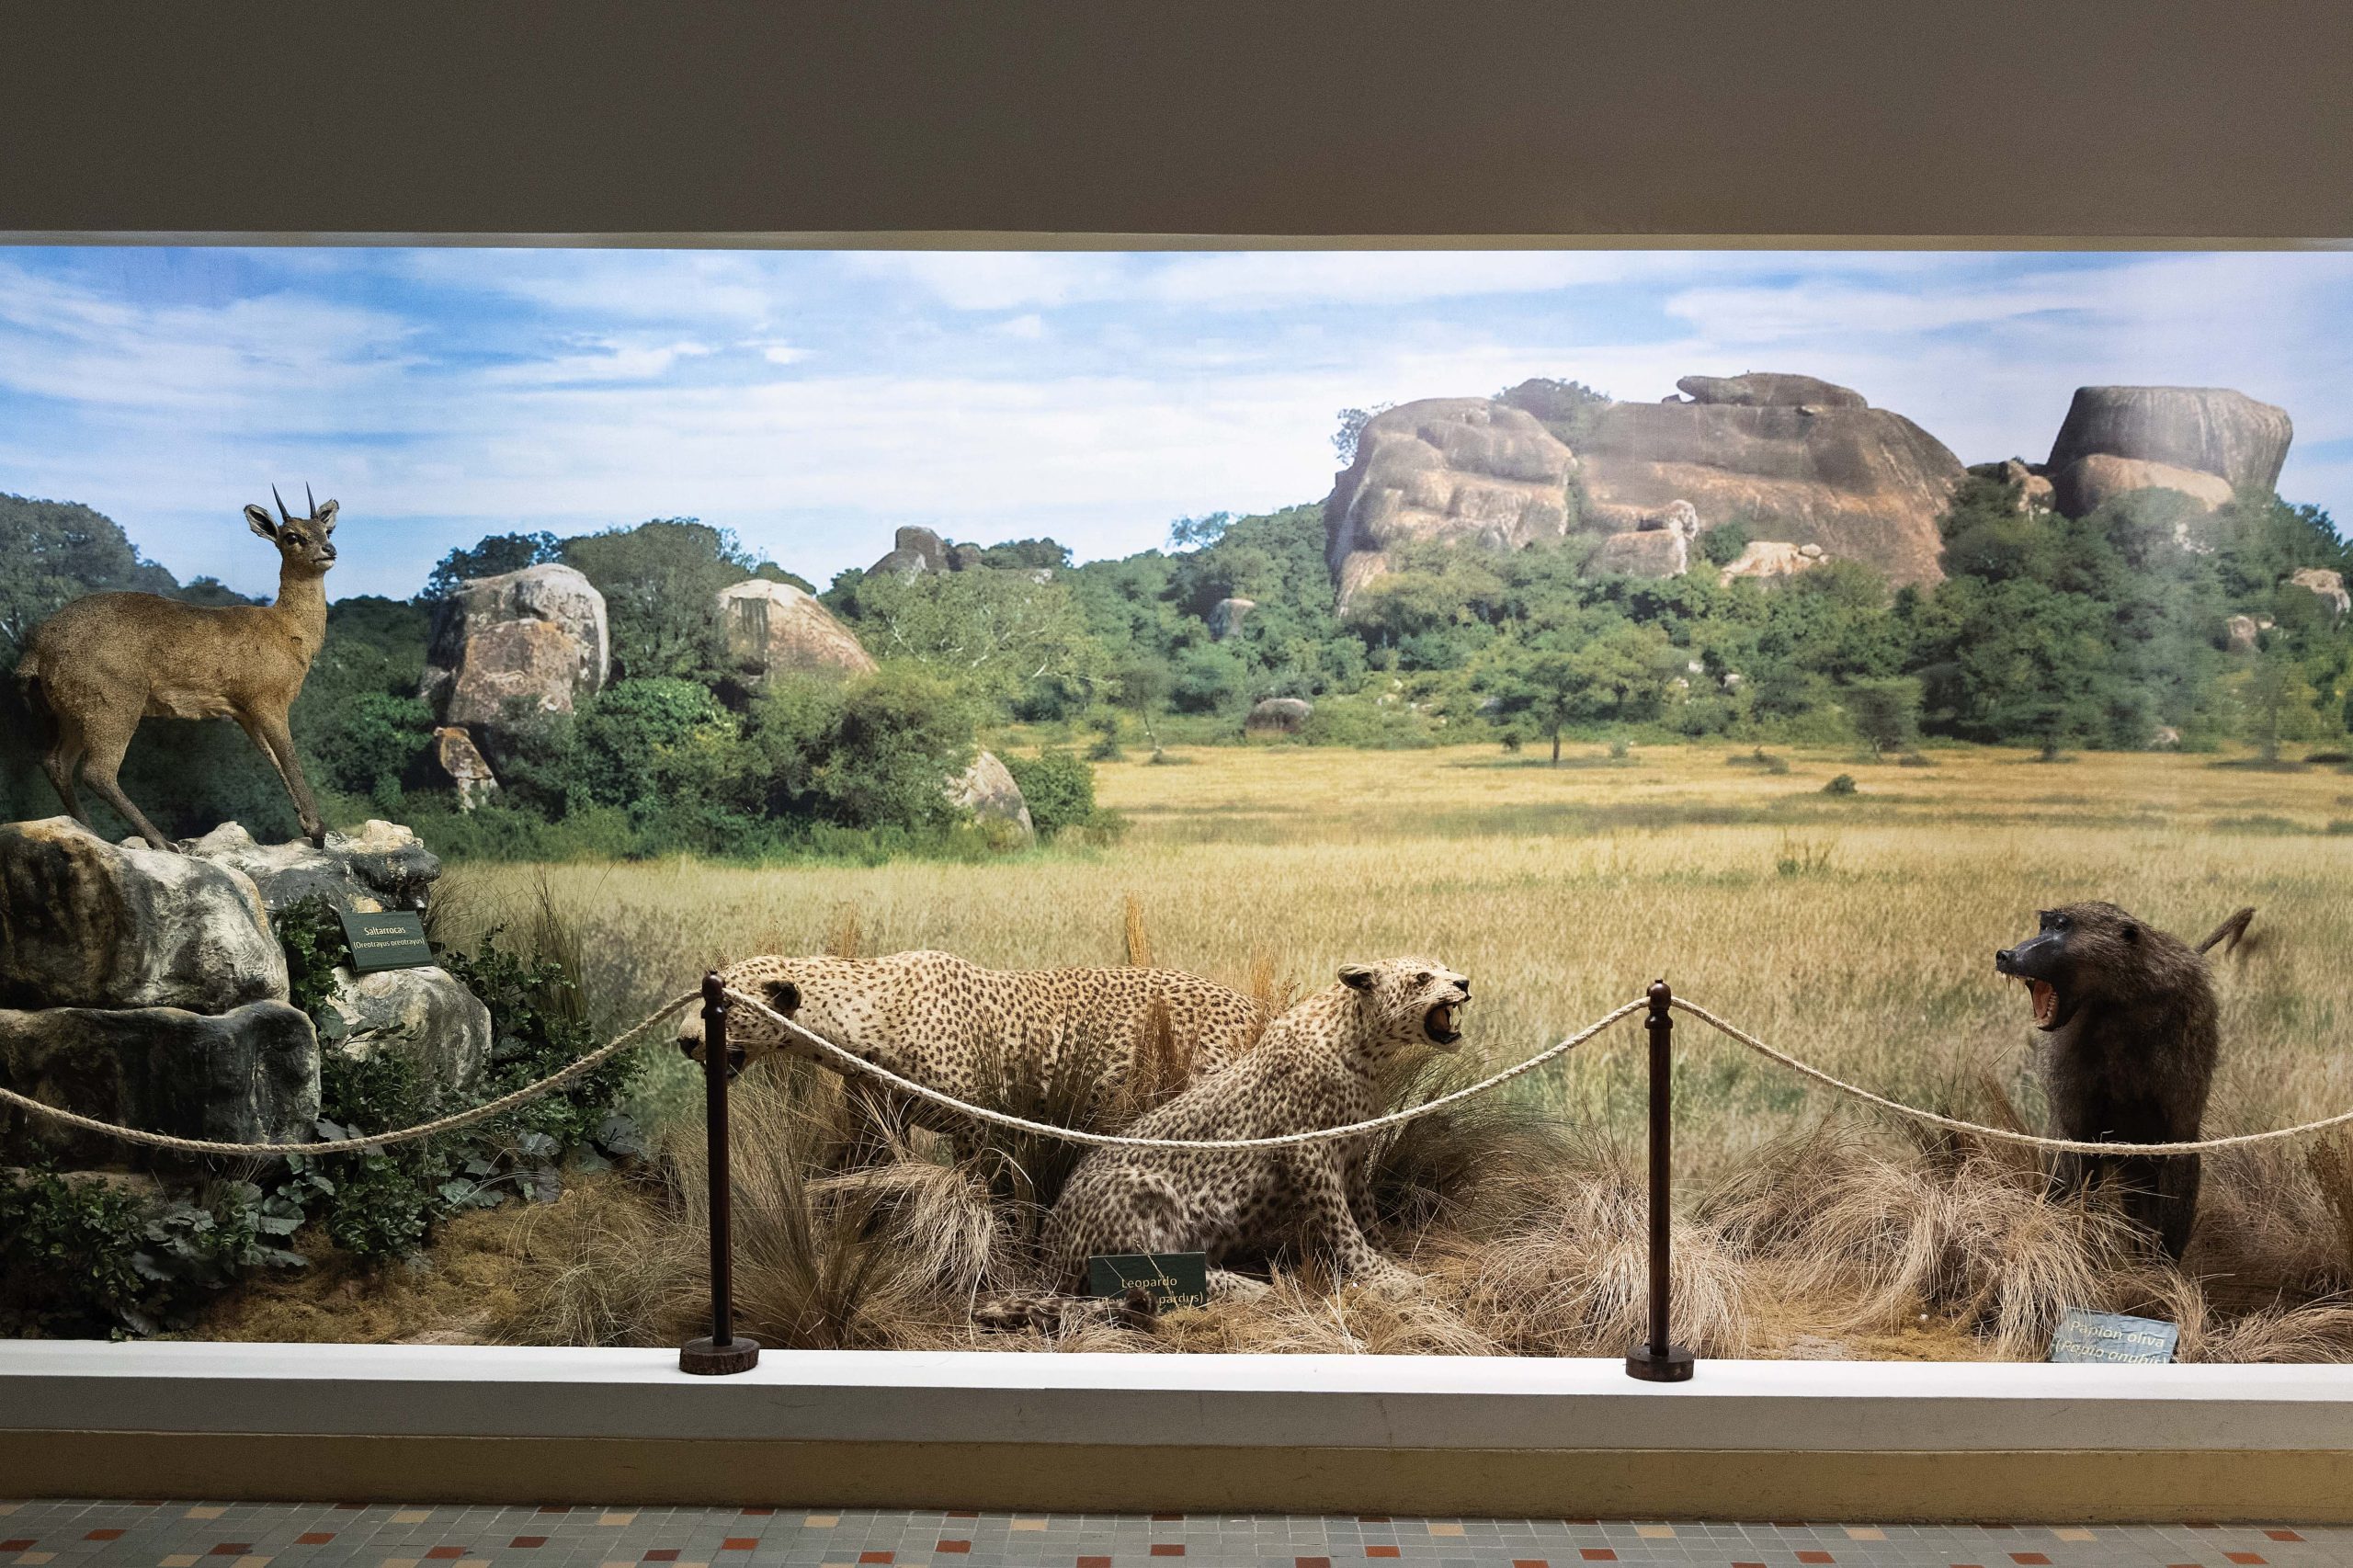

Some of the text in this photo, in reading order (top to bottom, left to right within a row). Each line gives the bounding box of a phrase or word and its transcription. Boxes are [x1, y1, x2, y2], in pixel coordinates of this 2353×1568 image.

[364, 926, 406, 936] Saltarrocas
[1121, 1275, 1177, 1290] Leopardo
[2127, 1331, 2165, 1348] oliva
